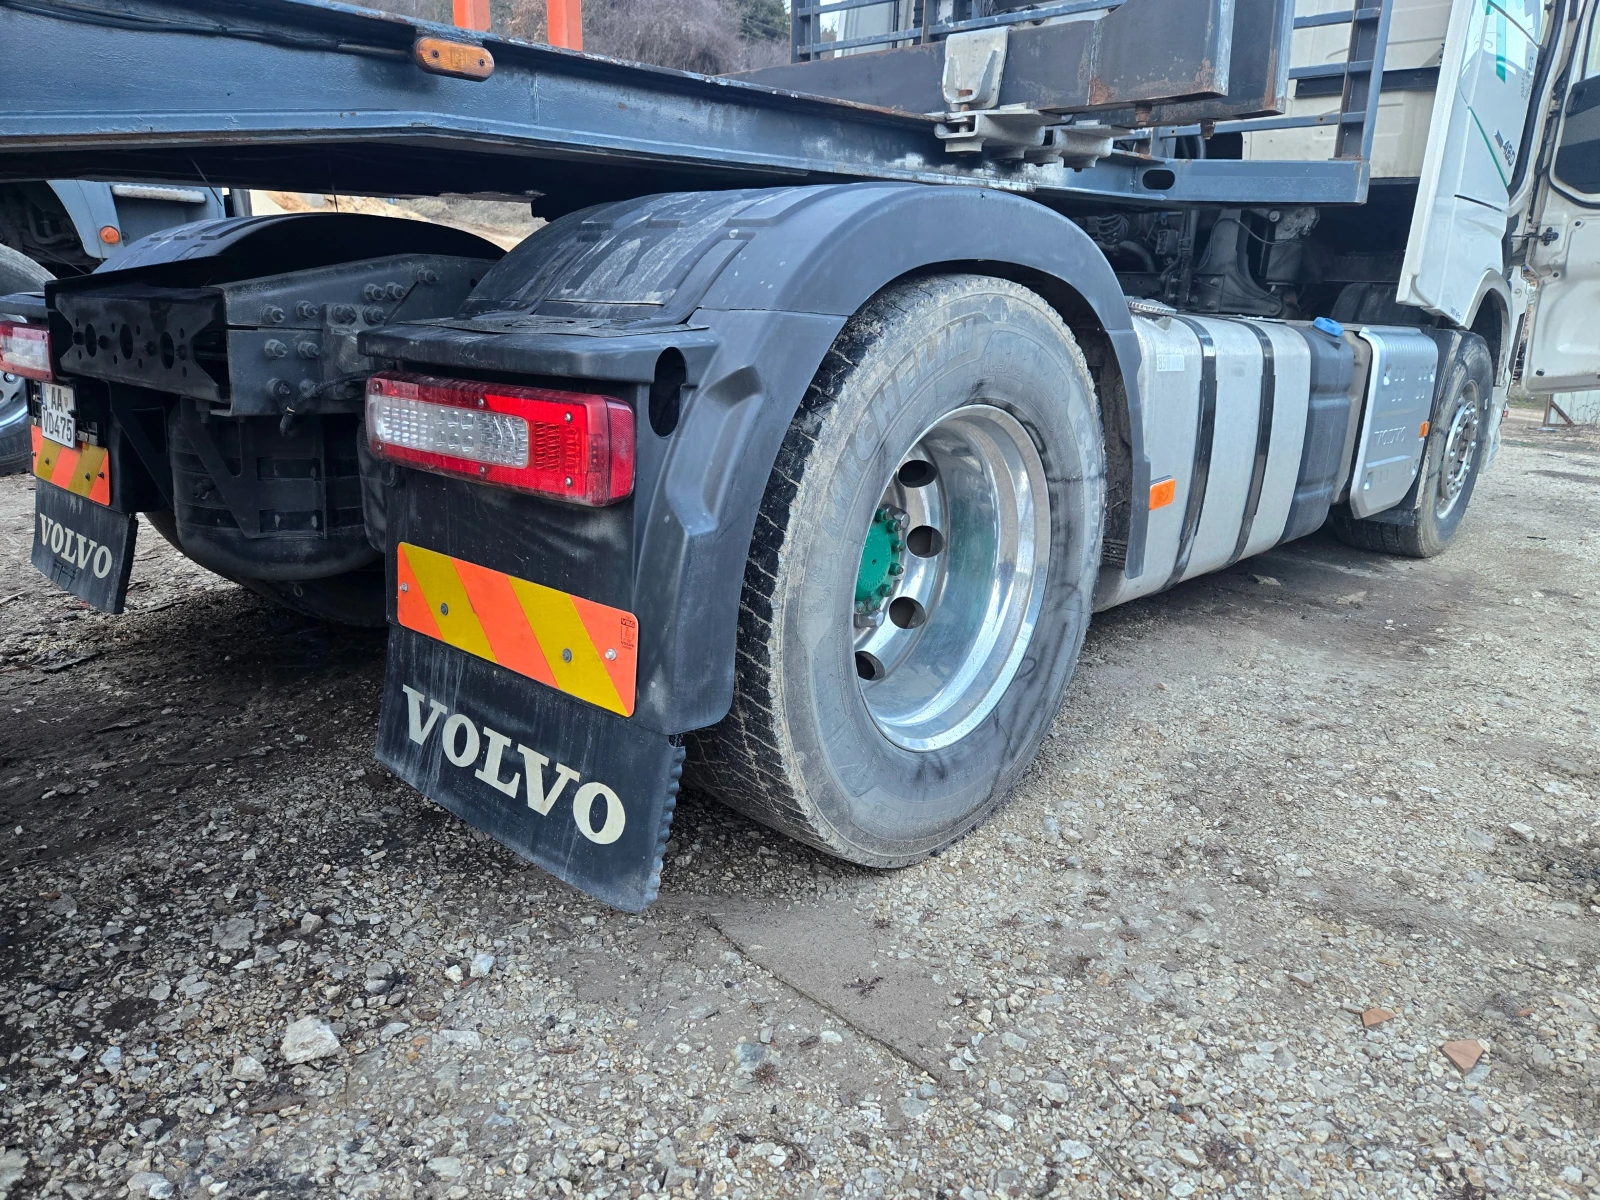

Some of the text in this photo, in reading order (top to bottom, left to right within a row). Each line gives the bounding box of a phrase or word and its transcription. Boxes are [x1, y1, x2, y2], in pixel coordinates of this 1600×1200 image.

[43, 410, 73, 443] VD475
[50, 386, 64, 413] AA
[819, 317, 976, 544] MICHELIN
[39, 512, 113, 579] VOLVO
[402, 684, 626, 845] VOLVO
